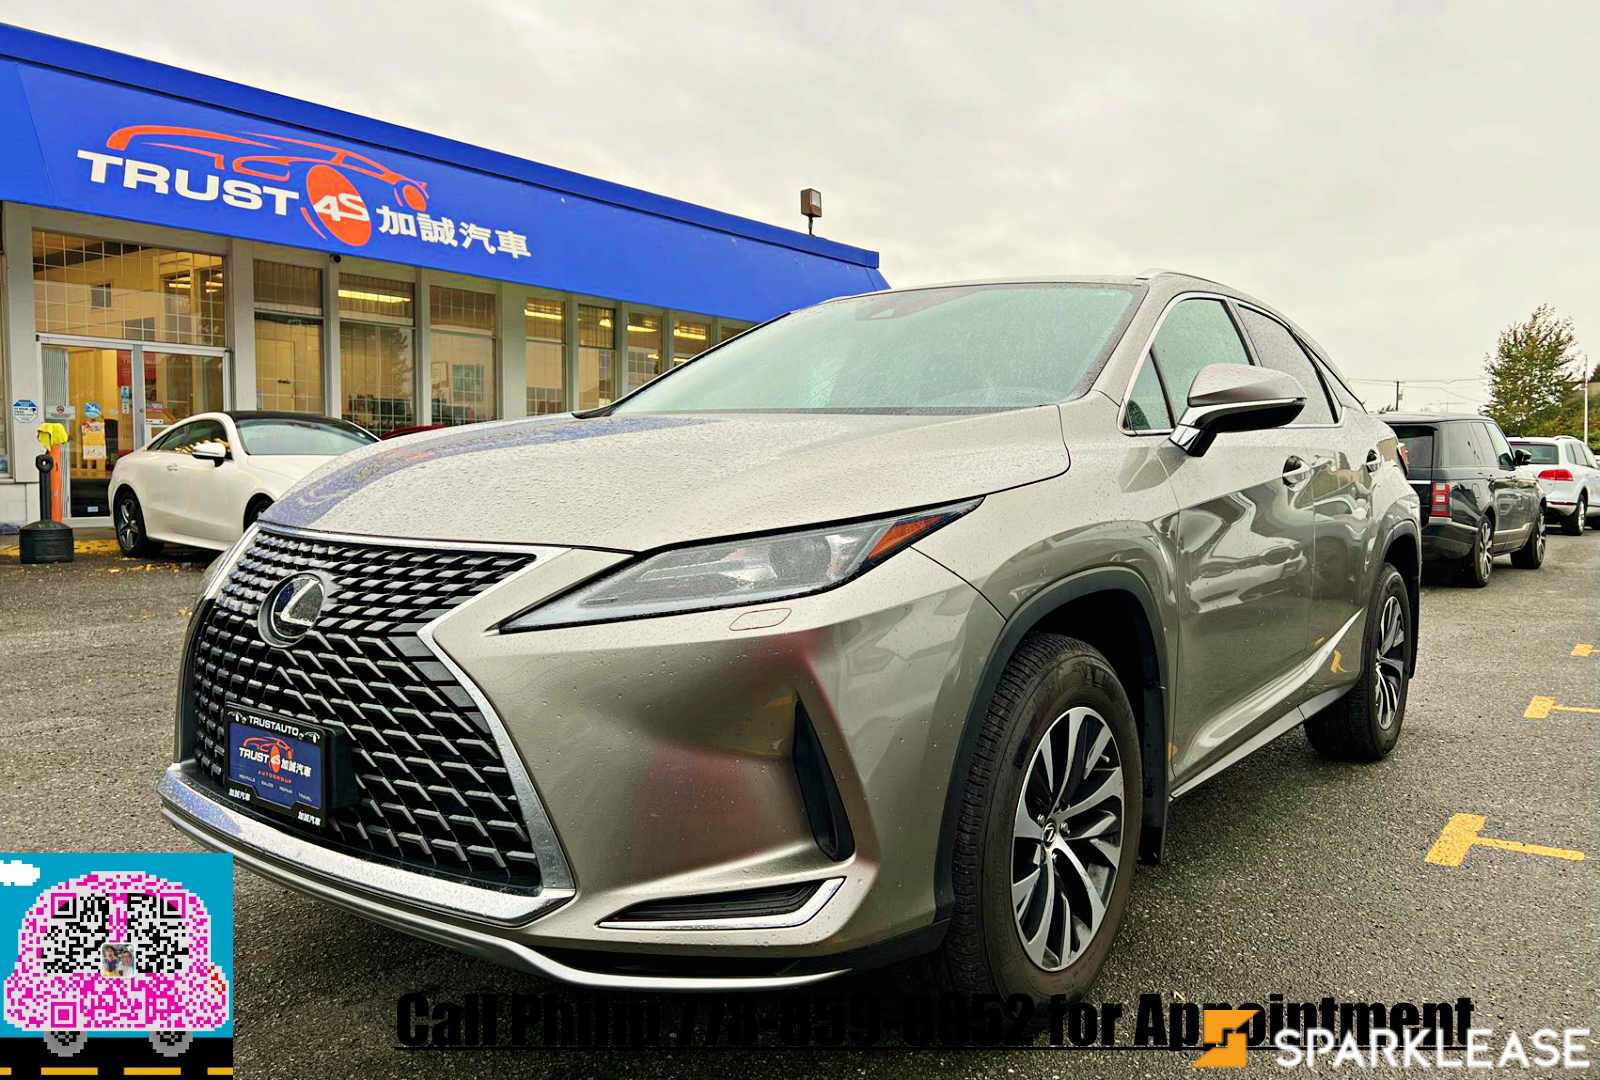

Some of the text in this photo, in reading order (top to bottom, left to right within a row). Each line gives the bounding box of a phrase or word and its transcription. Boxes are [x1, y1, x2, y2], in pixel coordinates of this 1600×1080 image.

[77, 149, 532, 259] TRUST 4S 加誠汽車
[248, 715, 299, 736] TRUSTAUTO
[239, 747, 269, 764] TRUST
